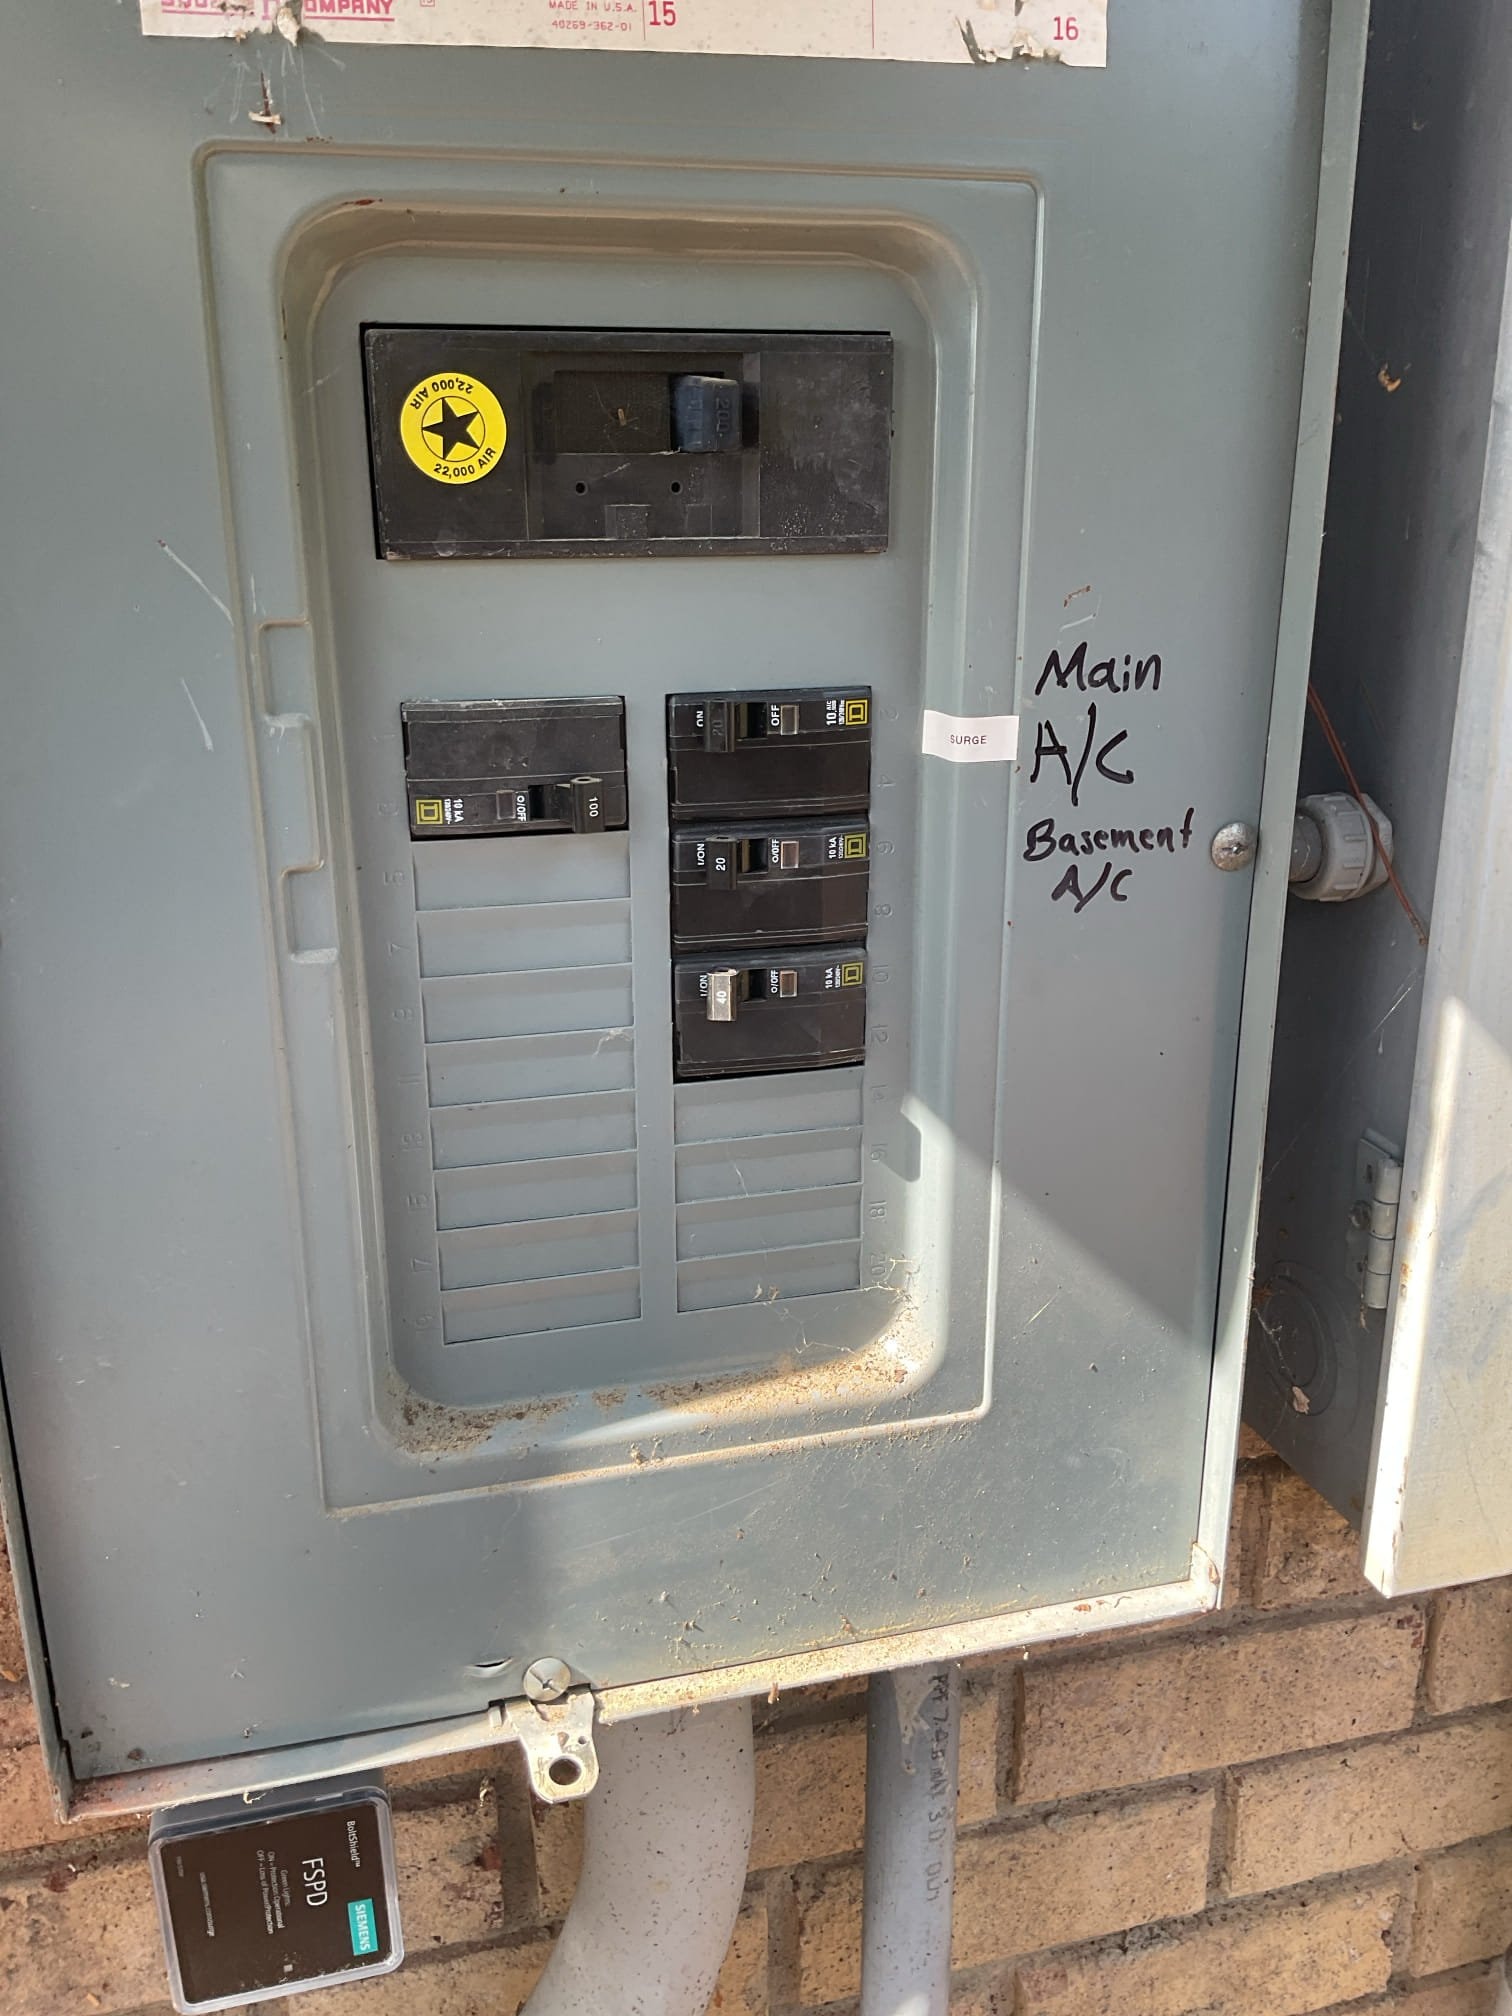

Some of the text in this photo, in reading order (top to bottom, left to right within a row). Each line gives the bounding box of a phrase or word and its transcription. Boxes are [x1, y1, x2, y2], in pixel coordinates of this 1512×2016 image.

[304, 0, 392, 14] OMPANY
[549, 0, 637, 13] MADE IN U.S.A.
[648, 1, 677, 26] 15
[552, 20, 632, 31] 40269-362-01
[1053, 16, 1079, 41] 16
[410, 378, 474, 410] 22,000 AIR
[433, 447, 496, 479] 22,000 AIR
[1034, 641, 1162, 696] Main
[696, 710, 704, 727] ON
[771, 704, 780, 726] OFF
[950, 734, 987, 745] SURGE
[1030, 702, 1134, 807] A/C
[454, 799, 464, 823] 10 kA
[588, 796, 599, 818] 100
[1023, 807, 1195, 862] Basement
[828, 836, 837, 859] 10 kA
[716, 857, 726, 872] 20
[1051, 862, 1133, 913] A/C
[825, 967, 834, 989] 10 kA
[716, 990, 727, 1005] 40
[302, 1857, 328, 1906] FSPD
[354, 1903, 371, 1951] SIEMENS
